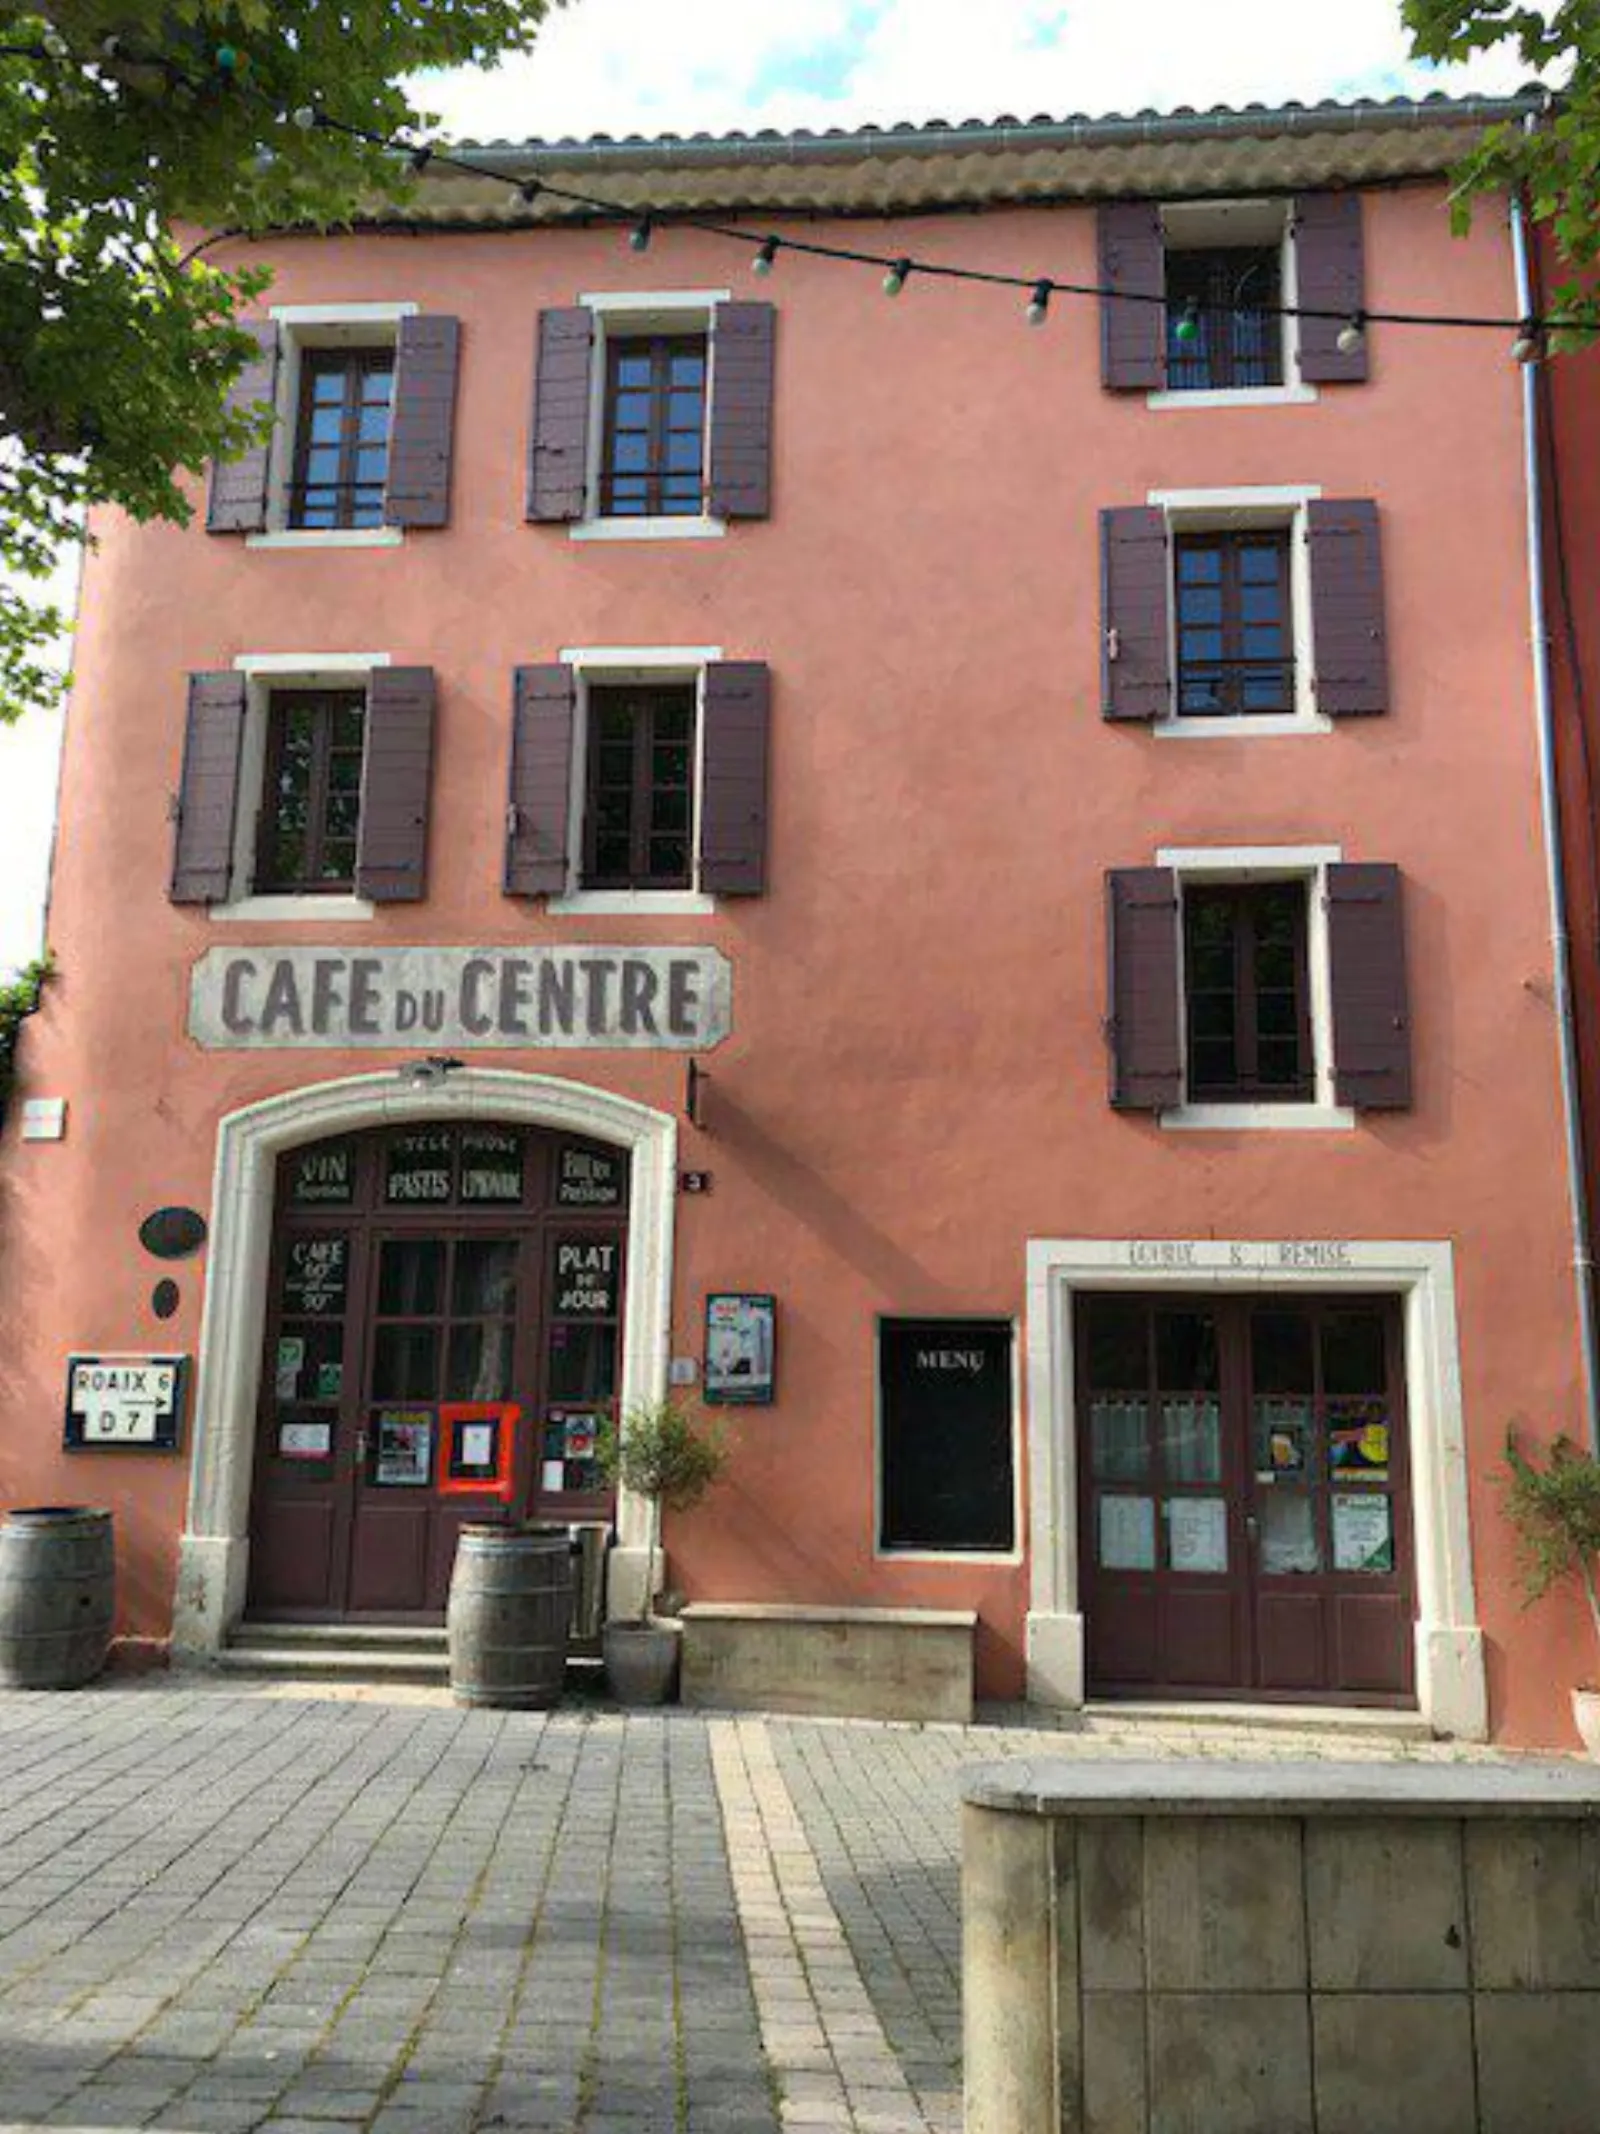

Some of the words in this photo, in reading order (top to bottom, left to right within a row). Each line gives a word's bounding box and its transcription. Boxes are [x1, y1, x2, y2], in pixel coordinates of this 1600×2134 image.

[220, 958, 383, 1035] CAFE
[395, 990, 444, 1032] DU
[459, 959, 700, 1037] CENTRE
[301, 1152, 347, 1182] VIN
[558, 1245, 615, 1275] PLAT
[558, 1290, 611, 1310] JOUR
[916, 1348, 985, 1375] MENU
[76, 1370, 147, 1393] ROAIX
[100, 1410, 116, 1432] D
[127, 1410, 141, 1434] 7
